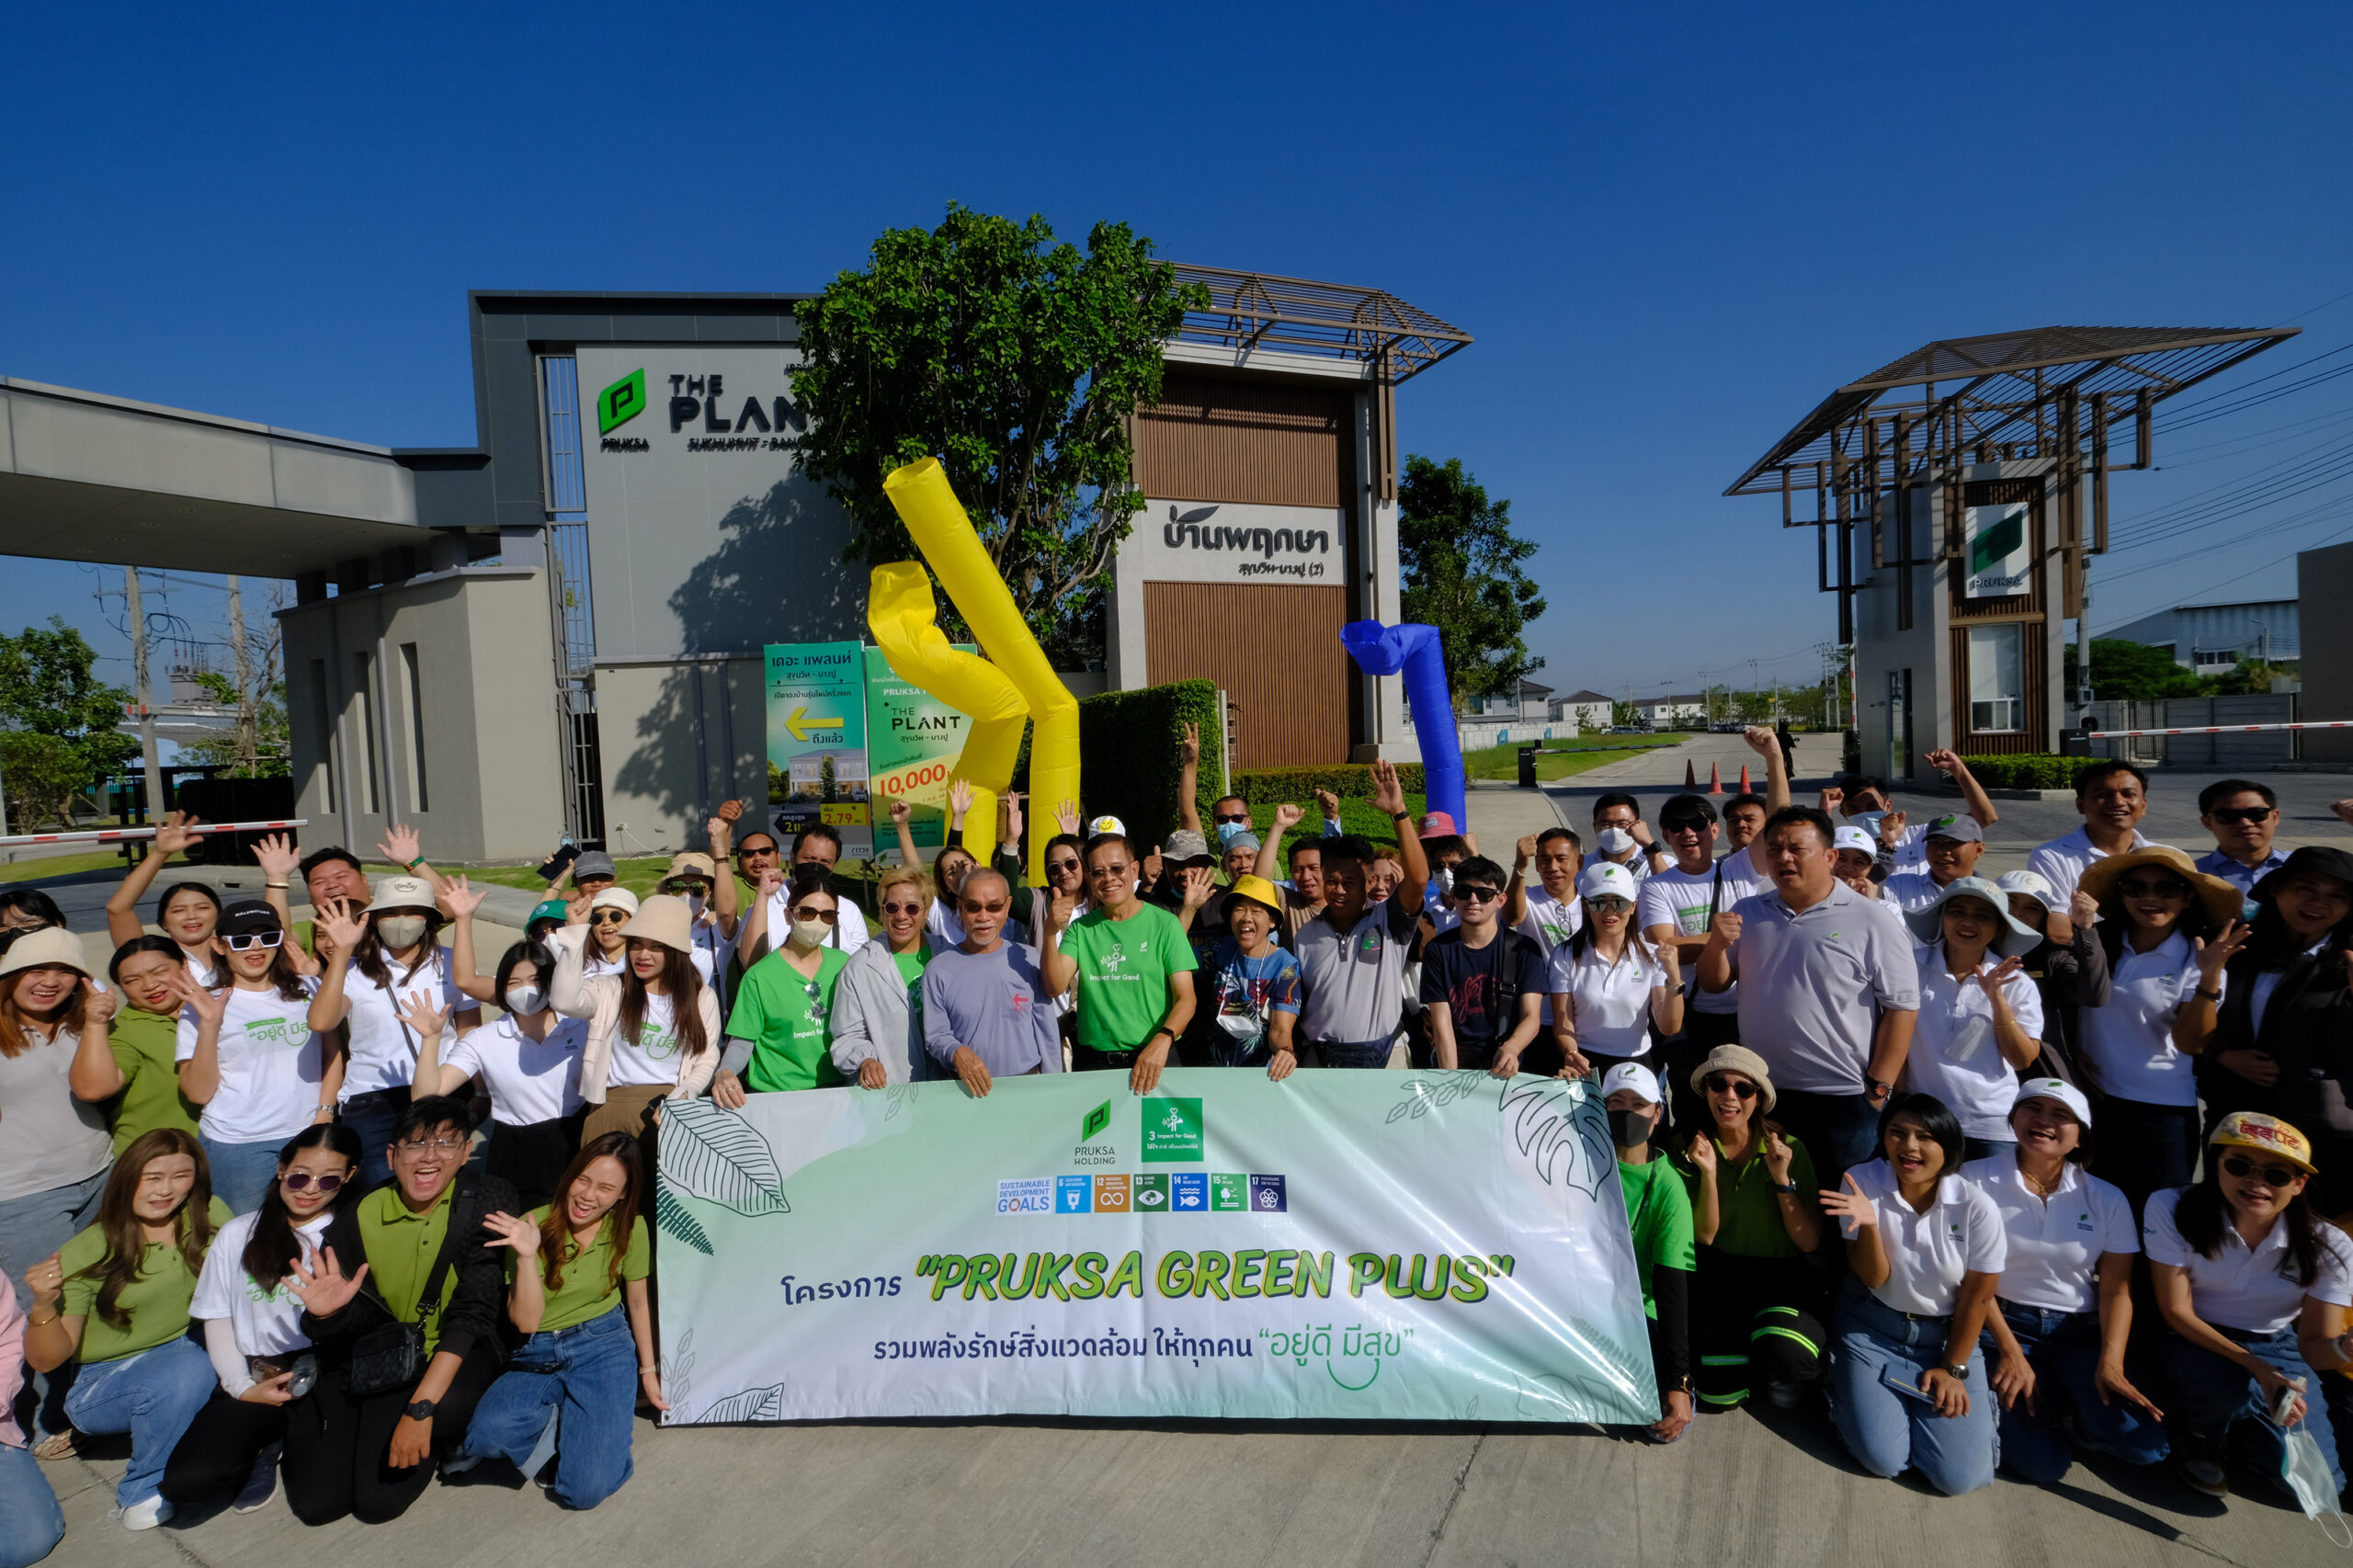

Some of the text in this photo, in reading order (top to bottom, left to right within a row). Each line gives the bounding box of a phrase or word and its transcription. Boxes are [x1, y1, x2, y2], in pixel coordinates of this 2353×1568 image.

[669, 374, 723, 395] THE
[669, 396, 808, 433] PLAN
[602, 438, 650, 450] PRUKSA
[688, 437, 760, 450] SUKHUMVIT
[1164, 505, 1329, 559] บ้านพฤกษา
[1308, 562, 1324, 577] (2)
[1972, 575, 2024, 590] PRUKSA
[772, 649, 852, 667] เดอะ แพลนท์
[883, 687, 921, 696] PRUKSA
[892, 708, 915, 716] THE
[892, 716, 961, 732] PLANT
[813, 733, 844, 744] ถึงแล้ว
[880, 764, 946, 798] 10,000
[824, 812, 854, 824] 2.79
[1149, 1131, 1155, 1141] 3
[1074, 1146, 1115, 1156] PRUKSA
[1074, 1157, 1116, 1165] HOLDING
[999, 1179, 1051, 1190] SUSTAINABLE
[1059, 1178, 1063, 1187] 6
[1097, 1177, 1104, 1187] 12
[1135, 1176, 1143, 1185] 13
[1174, 1176, 1181, 1185] 14
[1213, 1176, 1221, 1185] 15
[1252, 1176, 1259, 1186] 17
[999, 1187, 1050, 1199] DEVELOPMENT
[997, 1196, 1050, 1212] GOALS
[780, 1275, 903, 1305] โครงการ
[1155, 1249, 1336, 1301] GREEN
[874, 1324, 1147, 1360] รวมพลังรักษ์สิ่งแวดล้อม
[1153, 1326, 1253, 1368] ให้ทุกคน
